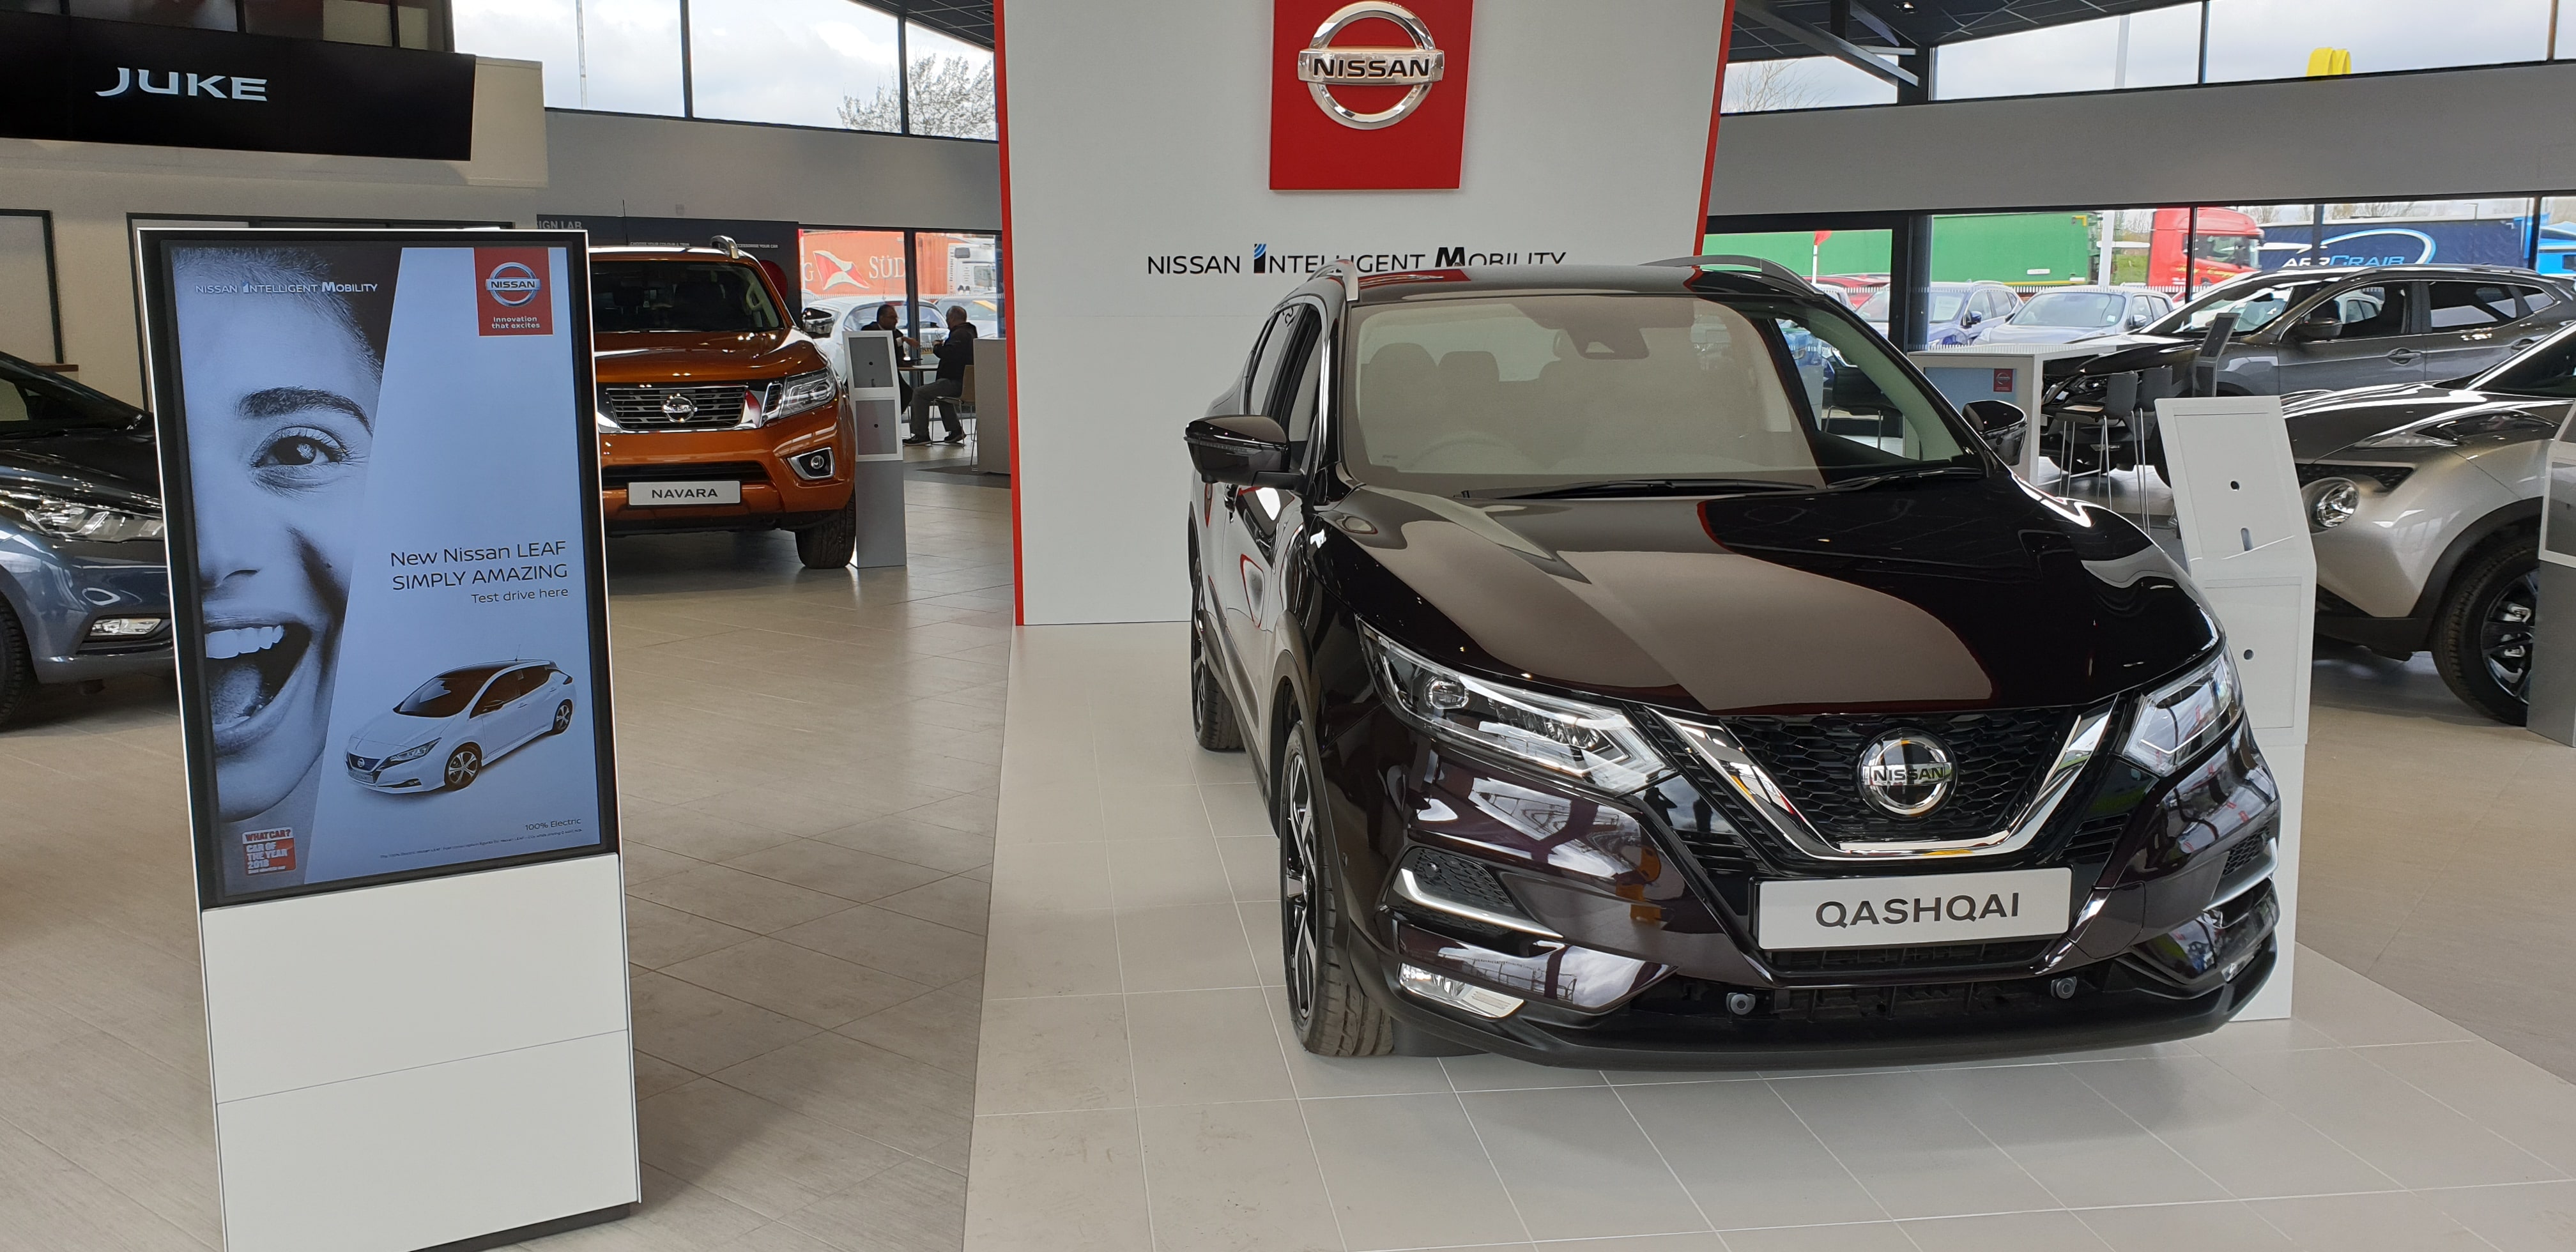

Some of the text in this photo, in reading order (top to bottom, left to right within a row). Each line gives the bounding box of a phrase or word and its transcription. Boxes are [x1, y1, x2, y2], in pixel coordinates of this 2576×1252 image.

[1312, 58, 1430, 78] NISSAN
[95, 66, 268, 102] JUKE
[535, 220, 582, 229] IGN LAB
[869, 256, 906, 279] SÜD
[1148, 256, 1240, 274] NISSAN
[195, 280, 378, 293] NISSAN INTELLIGENT MOBILITY
[491, 280, 535, 289] NISSAN
[652, 488, 718, 499] NAVARA
[390, 540, 567, 567] New Nissan LEAF
[392, 563, 568, 590] SIMPLY AMAZING
[471, 588, 569, 604] Test drive here
[1873, 766, 1944, 782] NISSAN
[525, 817, 581, 830] 100% Electric
[245, 828, 291, 841] WHAT CAR?
[246, 841, 277, 853] CAR OF
[247, 848, 288, 861] THE YEAR
[1815, 892, 2020, 929] QASHQAI
